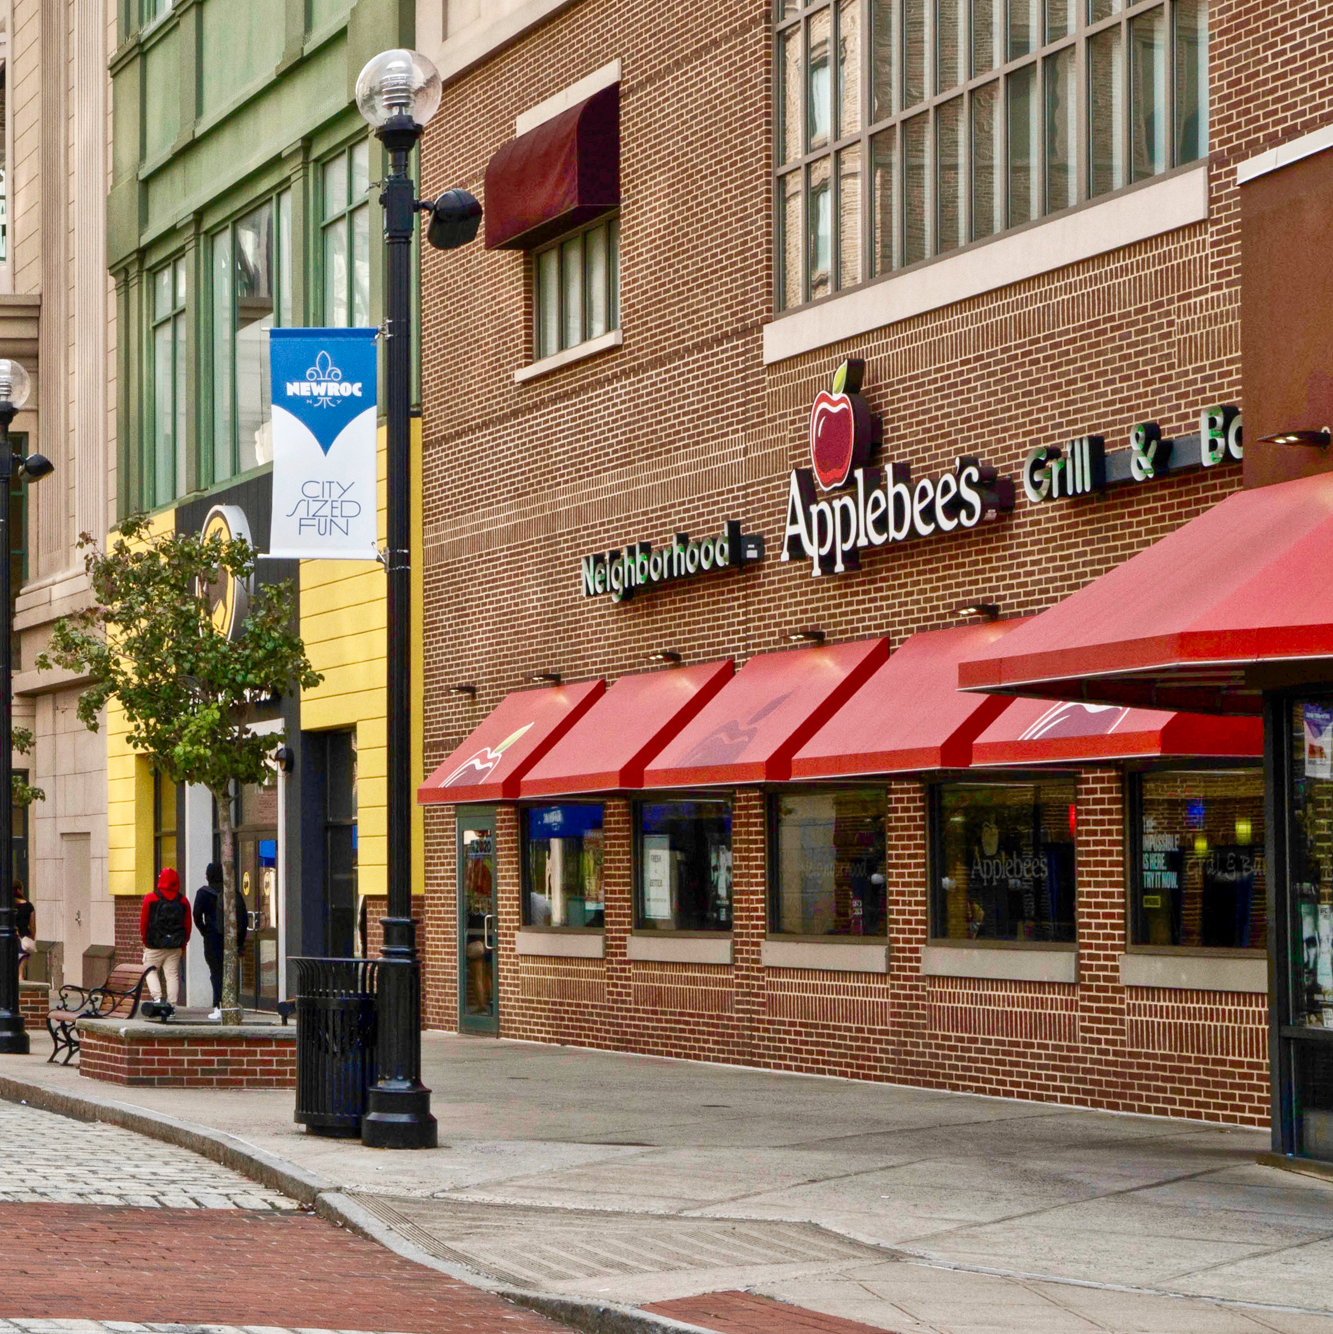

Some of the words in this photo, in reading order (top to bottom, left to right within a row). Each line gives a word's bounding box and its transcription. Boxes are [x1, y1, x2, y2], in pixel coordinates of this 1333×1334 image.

[286, 381, 363, 397] NEWROC
[1023, 436, 1094, 503] Grill
[1130, 423, 1159, 482] &
[301, 480, 355, 499] CITY
[286, 499, 362, 518] SIZED
[780, 456, 983, 577] Applebee's
[298, 518, 349, 536] FUN
[582, 520, 735, 603] Neighborhood
